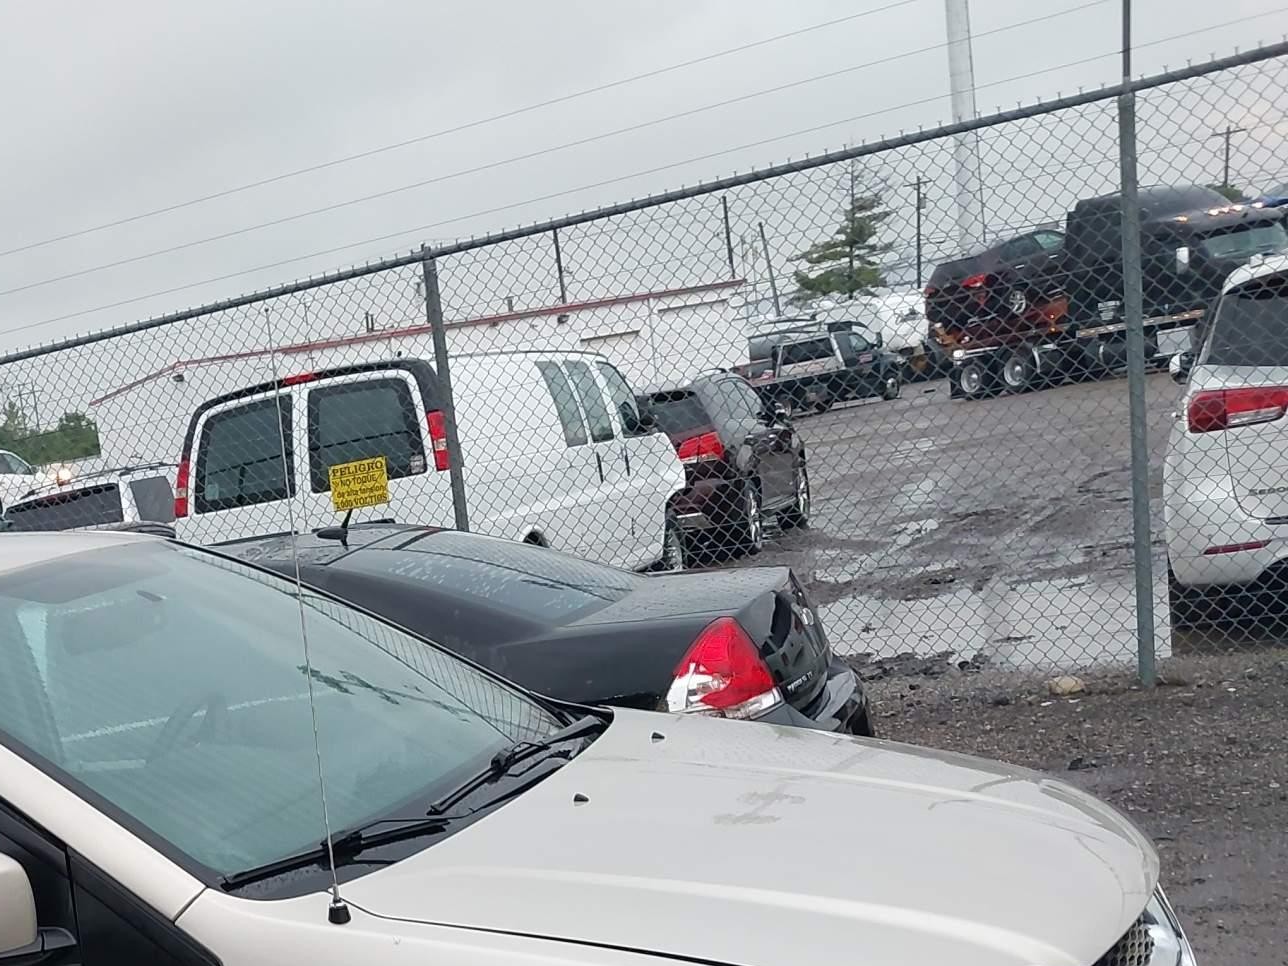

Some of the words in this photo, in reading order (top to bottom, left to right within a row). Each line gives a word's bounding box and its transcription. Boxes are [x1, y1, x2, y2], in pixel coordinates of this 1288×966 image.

[332, 460, 383, 477] PELIGRO
[340, 479, 351, 487] NO
[352, 474, 377, 485] TOQUE
[1248, 486, 1288, 497] SEDO
[354, 493, 388, 506] VOLTIOS
